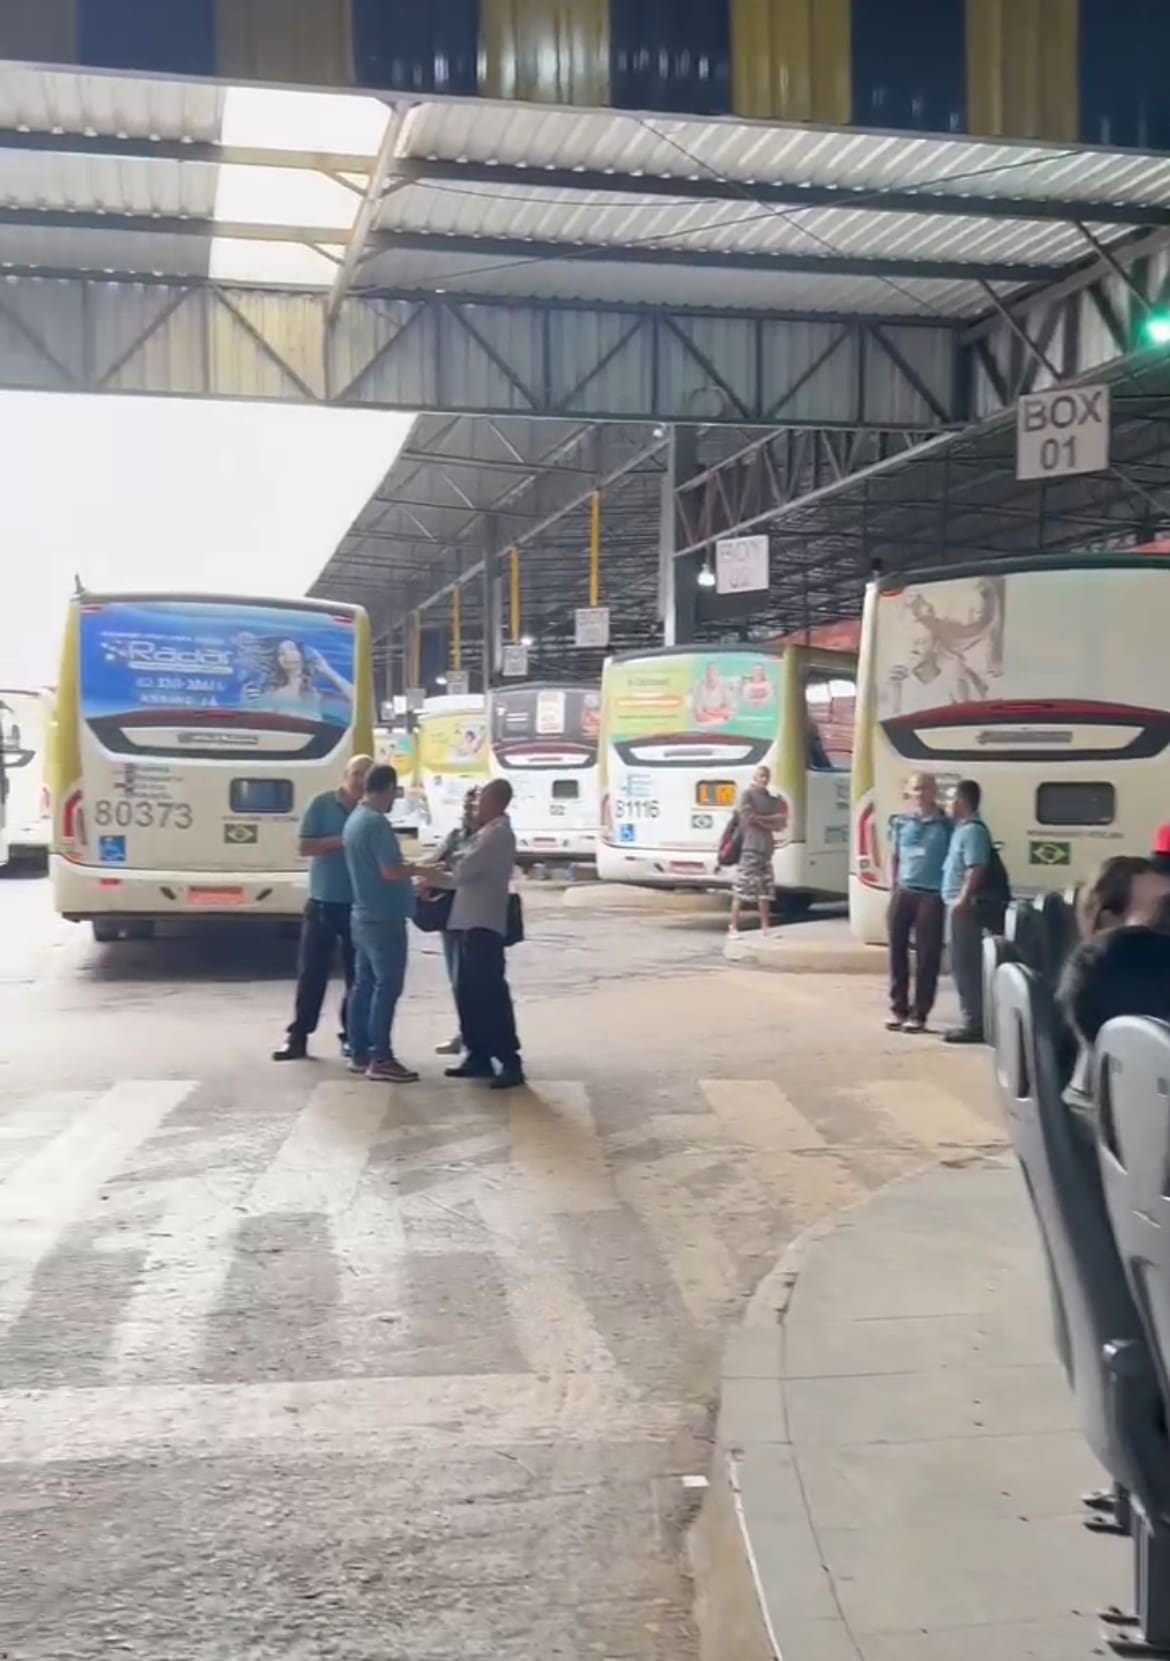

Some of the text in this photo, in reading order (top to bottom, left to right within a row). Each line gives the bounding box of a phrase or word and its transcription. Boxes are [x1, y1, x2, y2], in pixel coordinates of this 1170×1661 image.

[1024, 391, 1102, 432] BOX
[1041, 436, 1076, 470] 01
[128, 640, 234, 665] Radar
[95, 799, 194, 830] 80373
